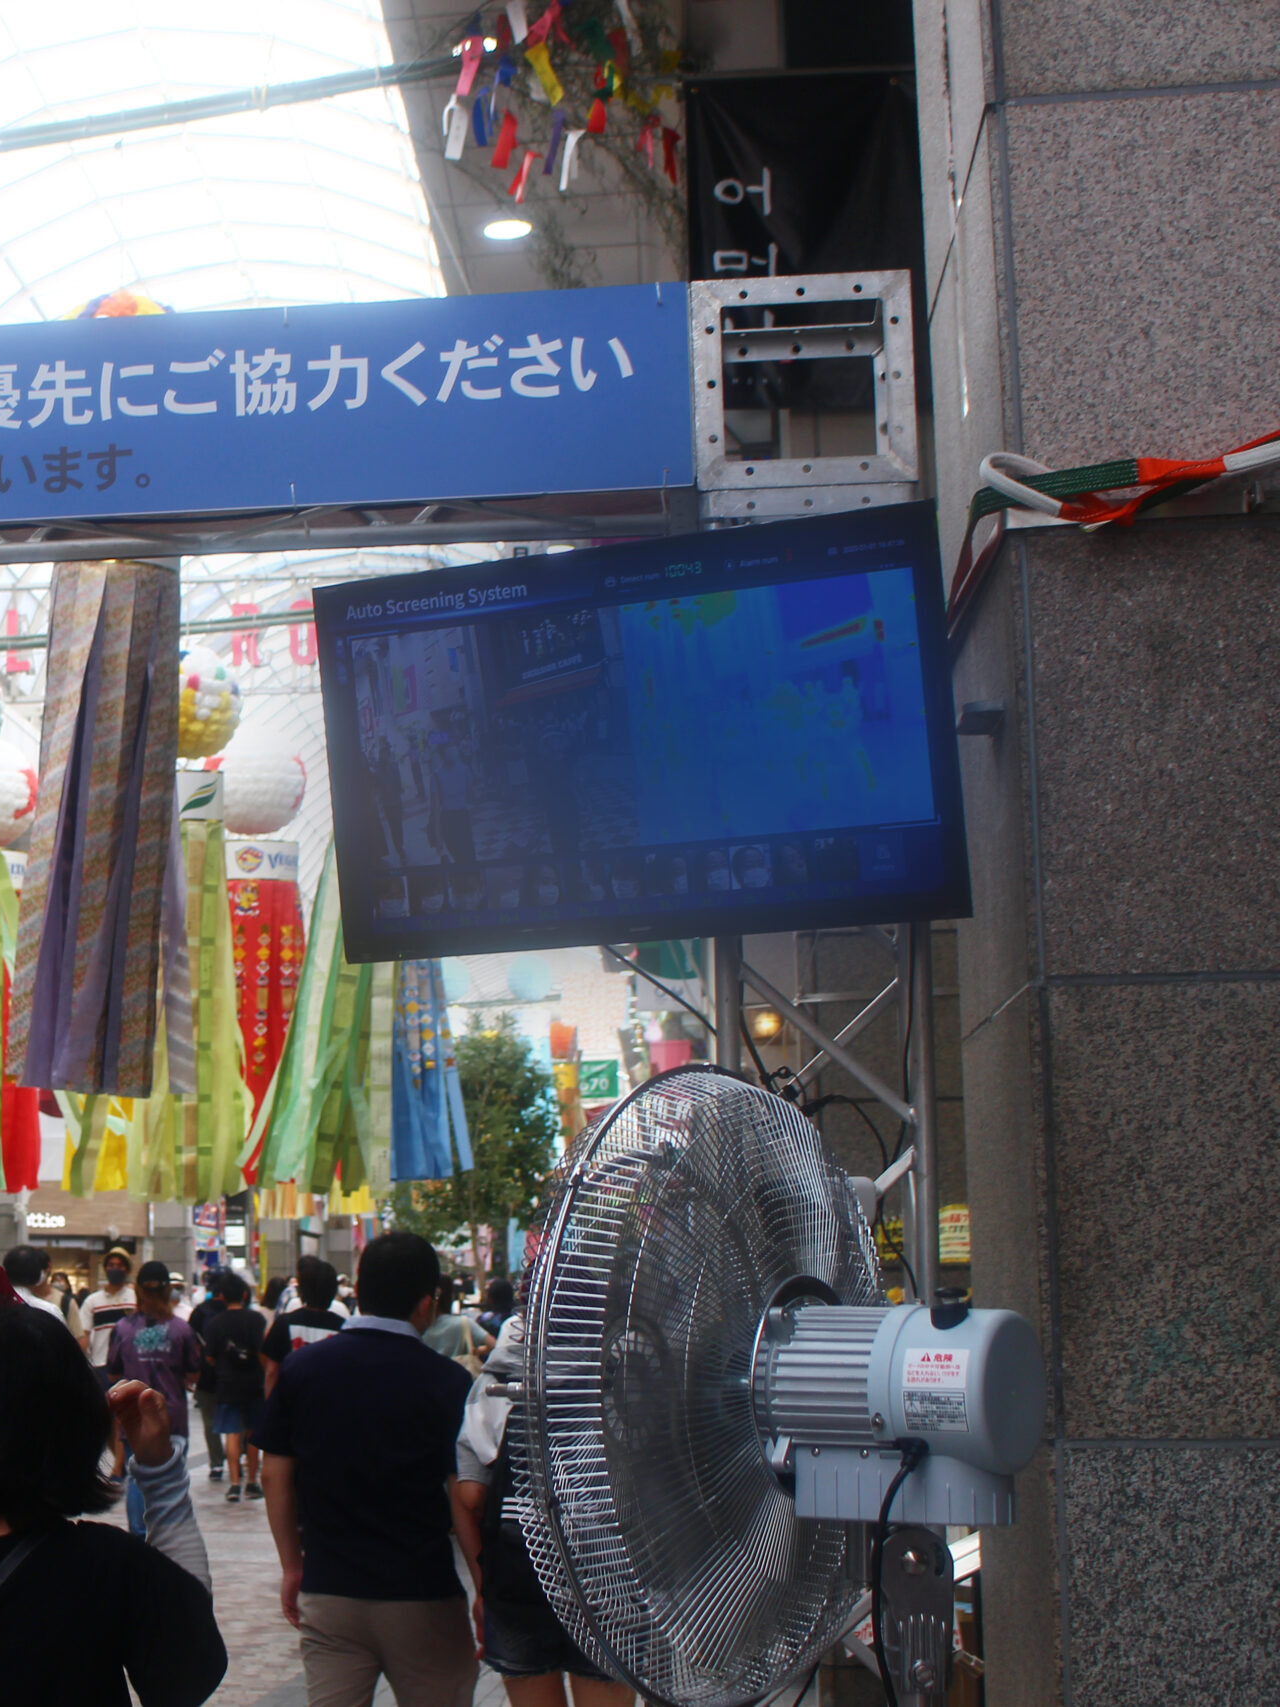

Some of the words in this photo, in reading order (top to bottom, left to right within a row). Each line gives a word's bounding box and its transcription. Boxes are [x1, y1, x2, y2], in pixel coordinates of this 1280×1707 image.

[346, 599, 382, 622] Auto
[386, 590, 465, 616] Screening
[468, 581, 528, 608] System
